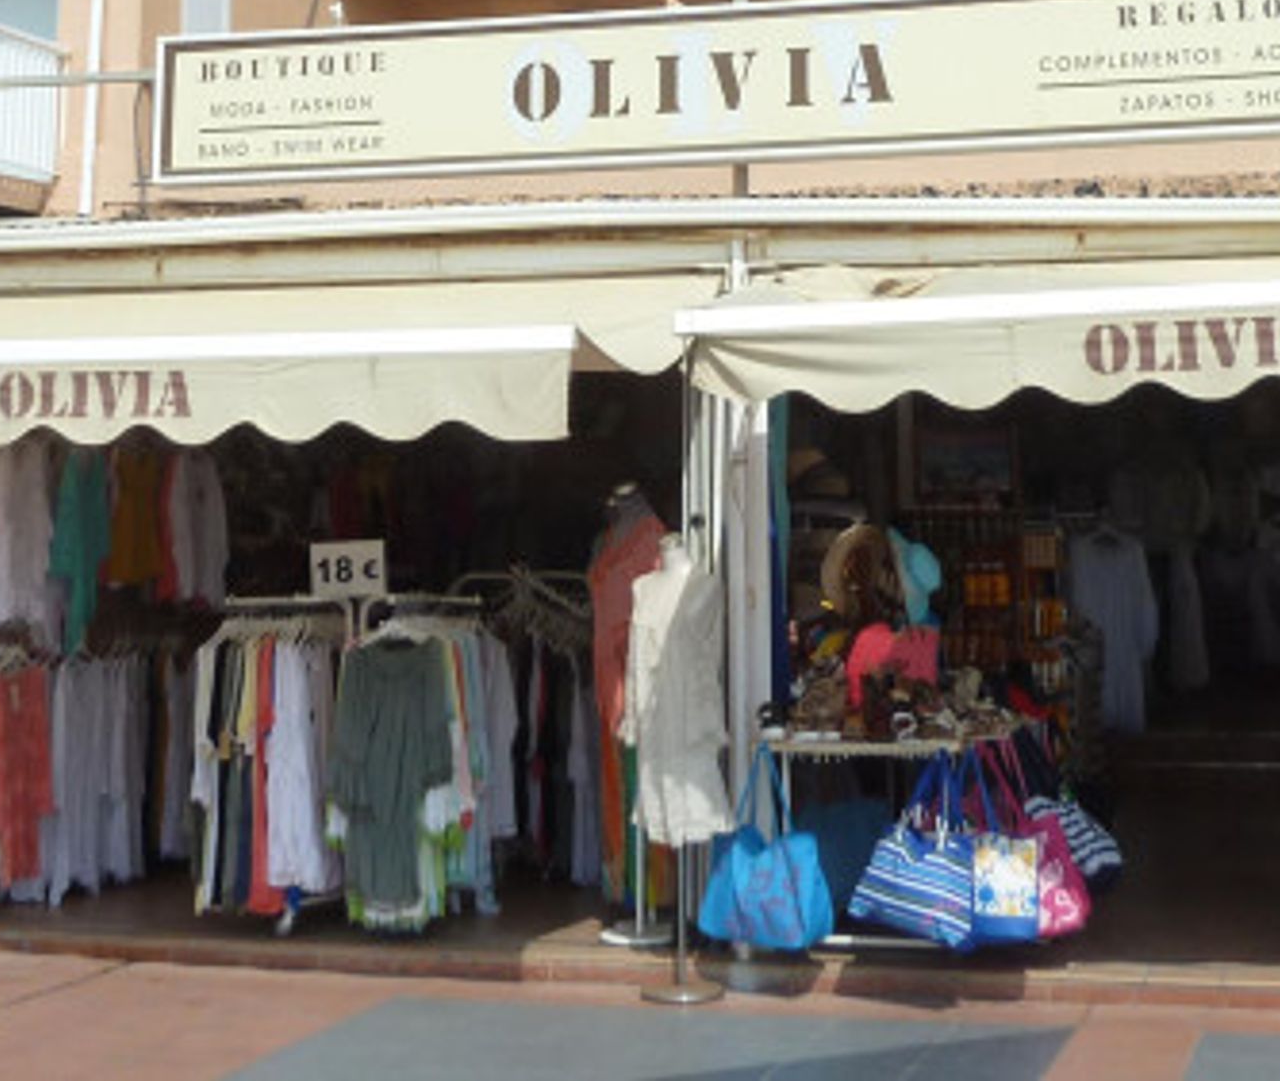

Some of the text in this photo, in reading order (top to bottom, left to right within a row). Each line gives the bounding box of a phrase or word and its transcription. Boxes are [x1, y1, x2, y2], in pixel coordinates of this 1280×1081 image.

[198, 51, 387, 83] BOUTIQUE
[1039, 47, 1222, 73] COMPLEMENTOS
[511, 42, 894, 123] OLIVIA
[290, 95, 373, 114] FASHION
[1118, 91, 1215, 114] ZAPATOS
